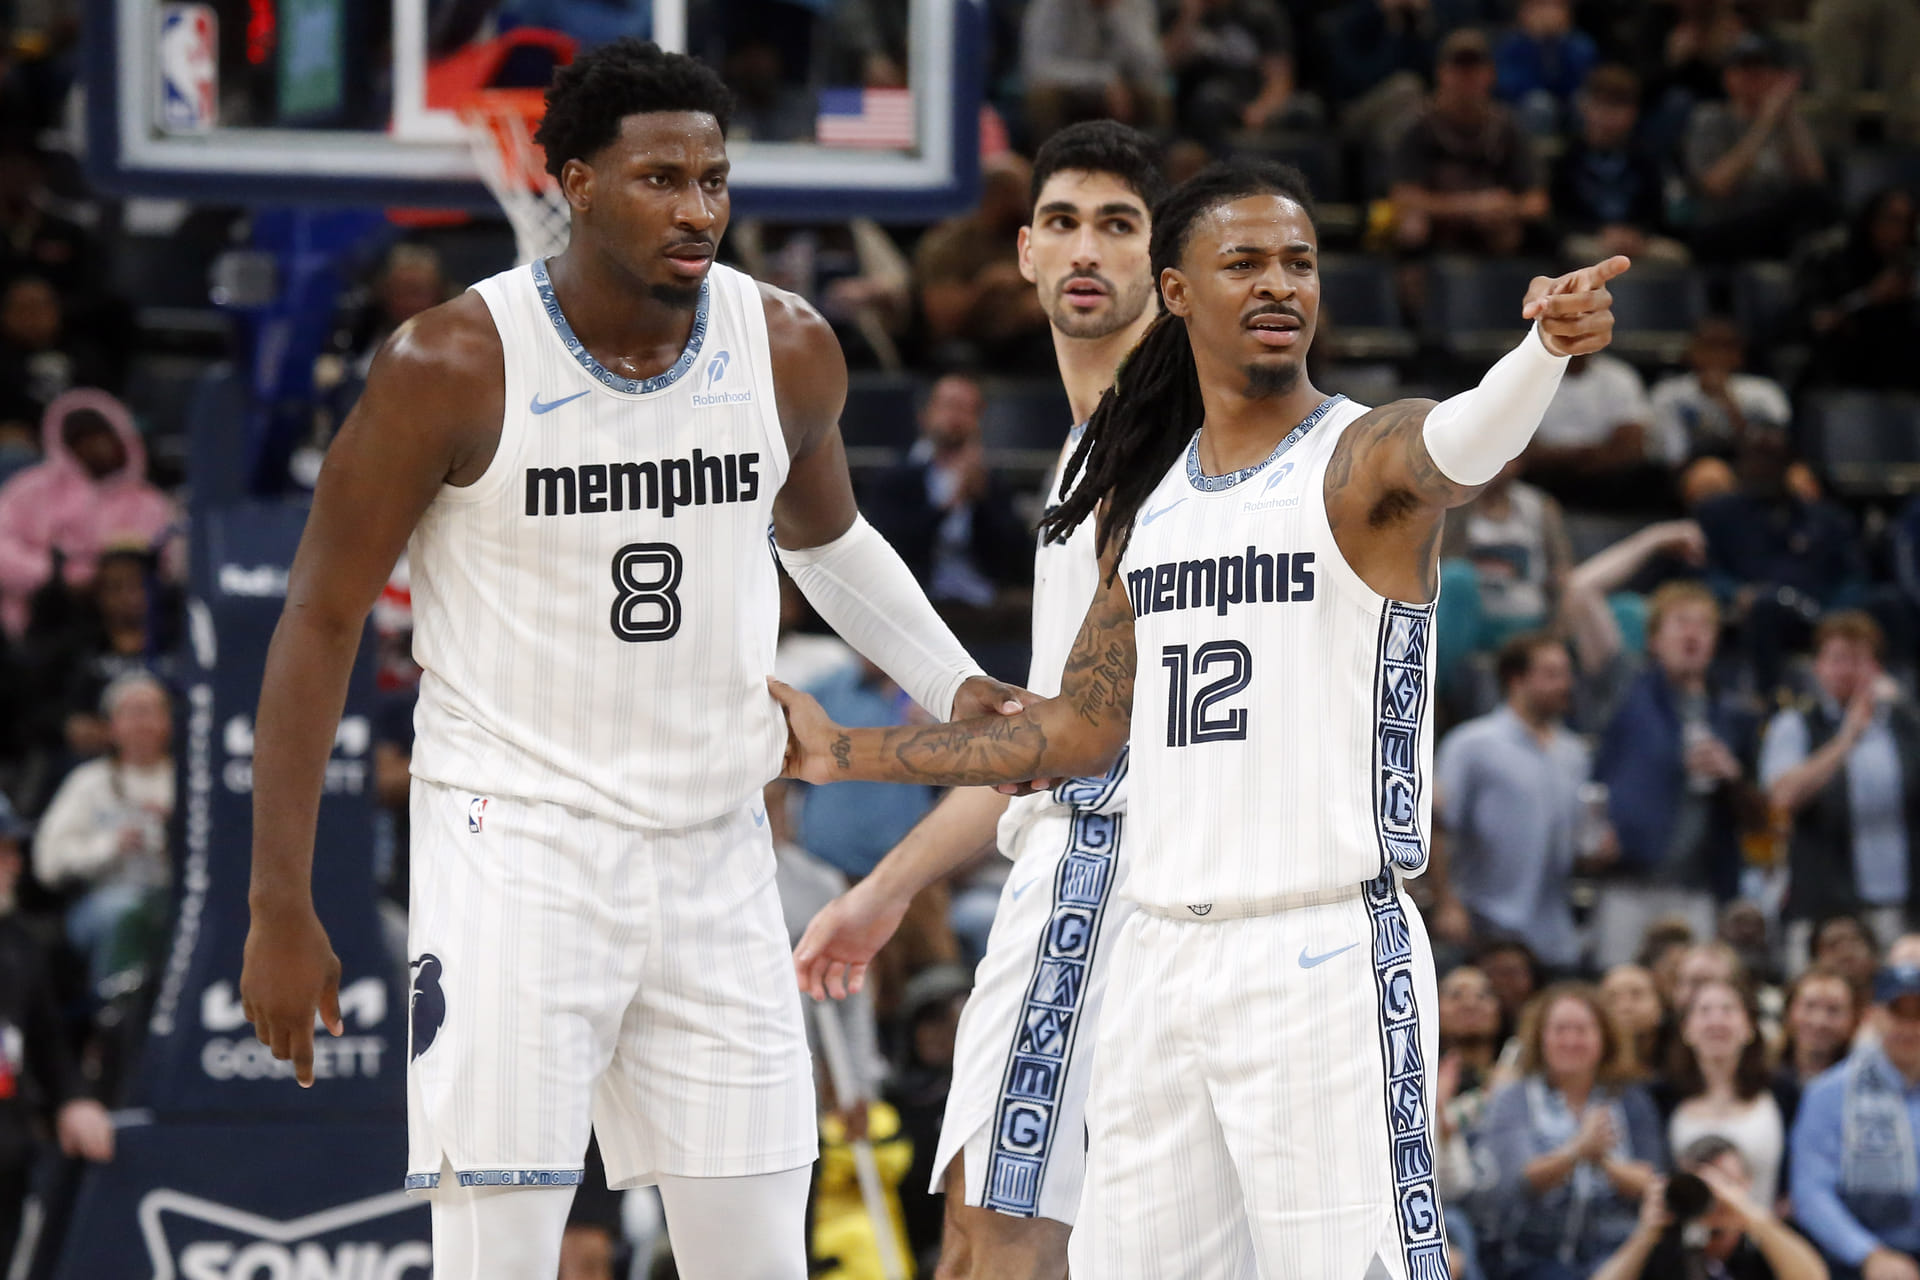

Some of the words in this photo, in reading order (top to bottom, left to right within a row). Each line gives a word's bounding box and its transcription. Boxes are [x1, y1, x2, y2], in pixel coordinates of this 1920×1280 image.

[692, 390, 751, 406] Robinhood
[525, 448, 759, 518] memphis
[1243, 496, 1299, 512] Robinhood
[610, 542, 683, 643] 8
[1127, 545, 1315, 620] memphis
[1162, 639, 1253, 748] 12
